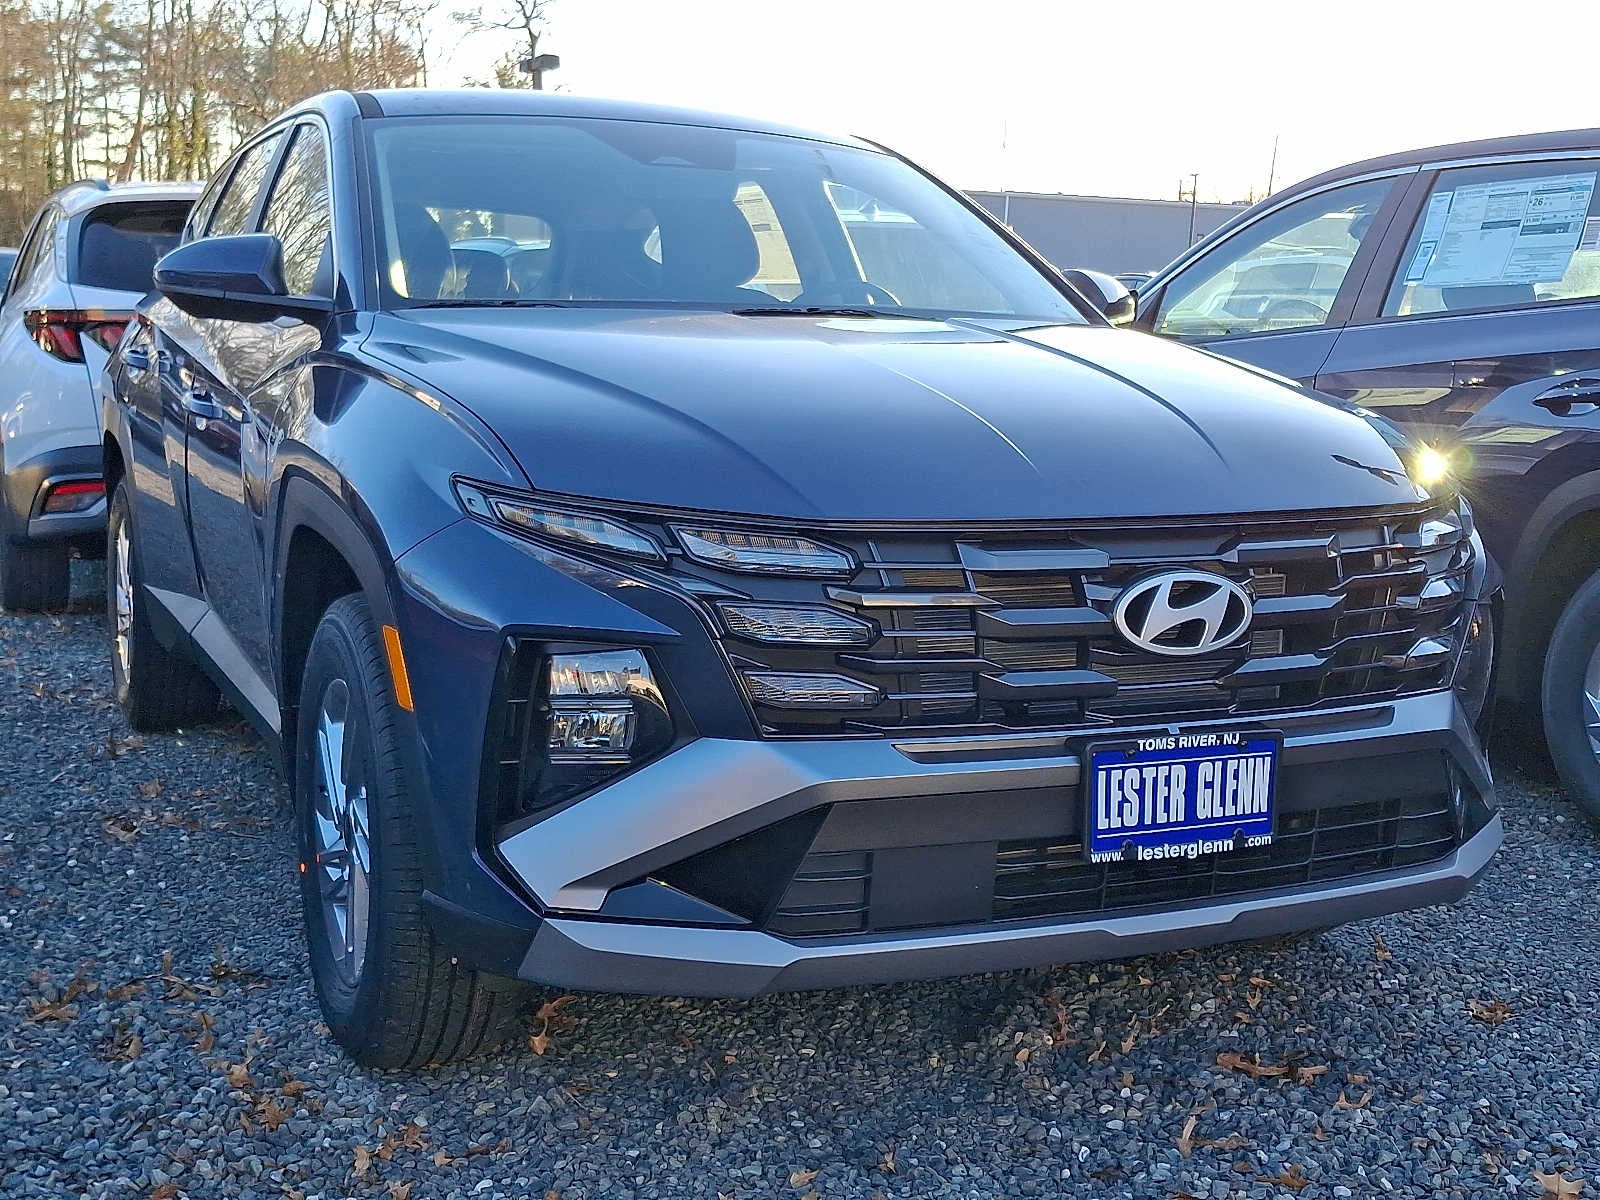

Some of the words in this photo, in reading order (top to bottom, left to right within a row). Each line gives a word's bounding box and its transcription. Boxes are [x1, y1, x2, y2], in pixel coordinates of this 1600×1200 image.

[1533, 197, 1544, 207] 26
[1137, 738, 1176, 752] TOMS
[1178, 734, 1220, 749] RIVER,
[1223, 732, 1240, 746] NJ
[1097, 764, 1187, 830] LESTER
[1196, 756, 1271, 820] GLENN
[1090, 851, 1124, 864] www.
[1137, 838, 1234, 861] lesterglenn
[1244, 835, 1272, 848] .com
